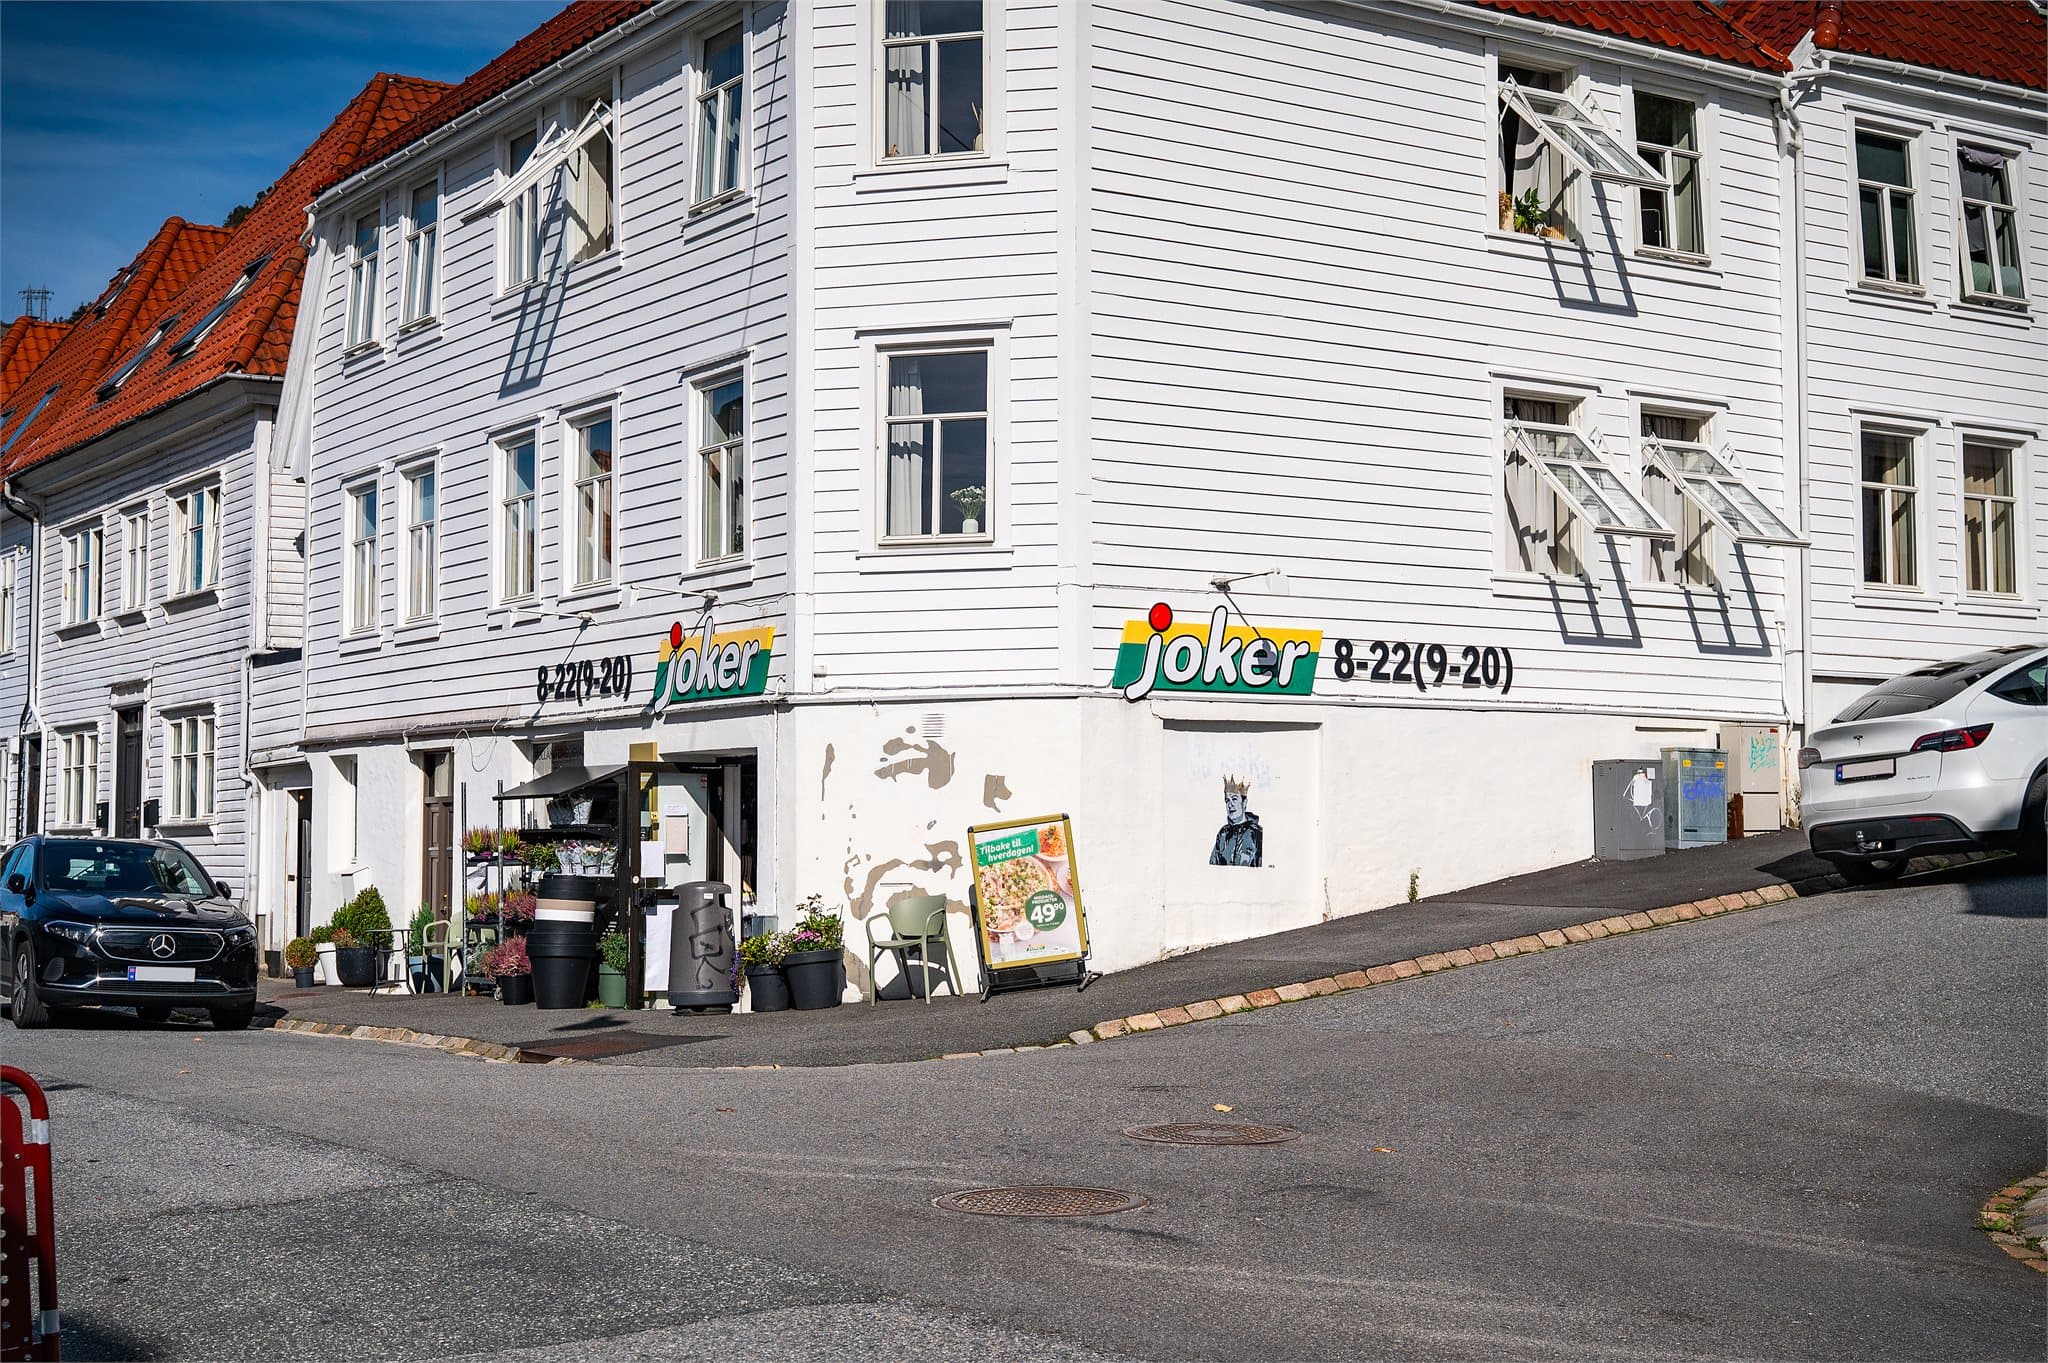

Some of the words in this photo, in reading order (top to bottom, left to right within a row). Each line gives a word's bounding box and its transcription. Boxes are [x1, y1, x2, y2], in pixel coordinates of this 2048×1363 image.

[654, 615, 760, 713] joker
[1123, 602, 1311, 701] joker
[1334, 638, 1513, 695] 8-22(9-20)
[537, 655, 632, 706] 8-22(9-20)
[980, 841, 1010, 854] Tilbake
[1012, 838, 1021, 848] til
[988, 844, 1034, 862] hverdagen!
